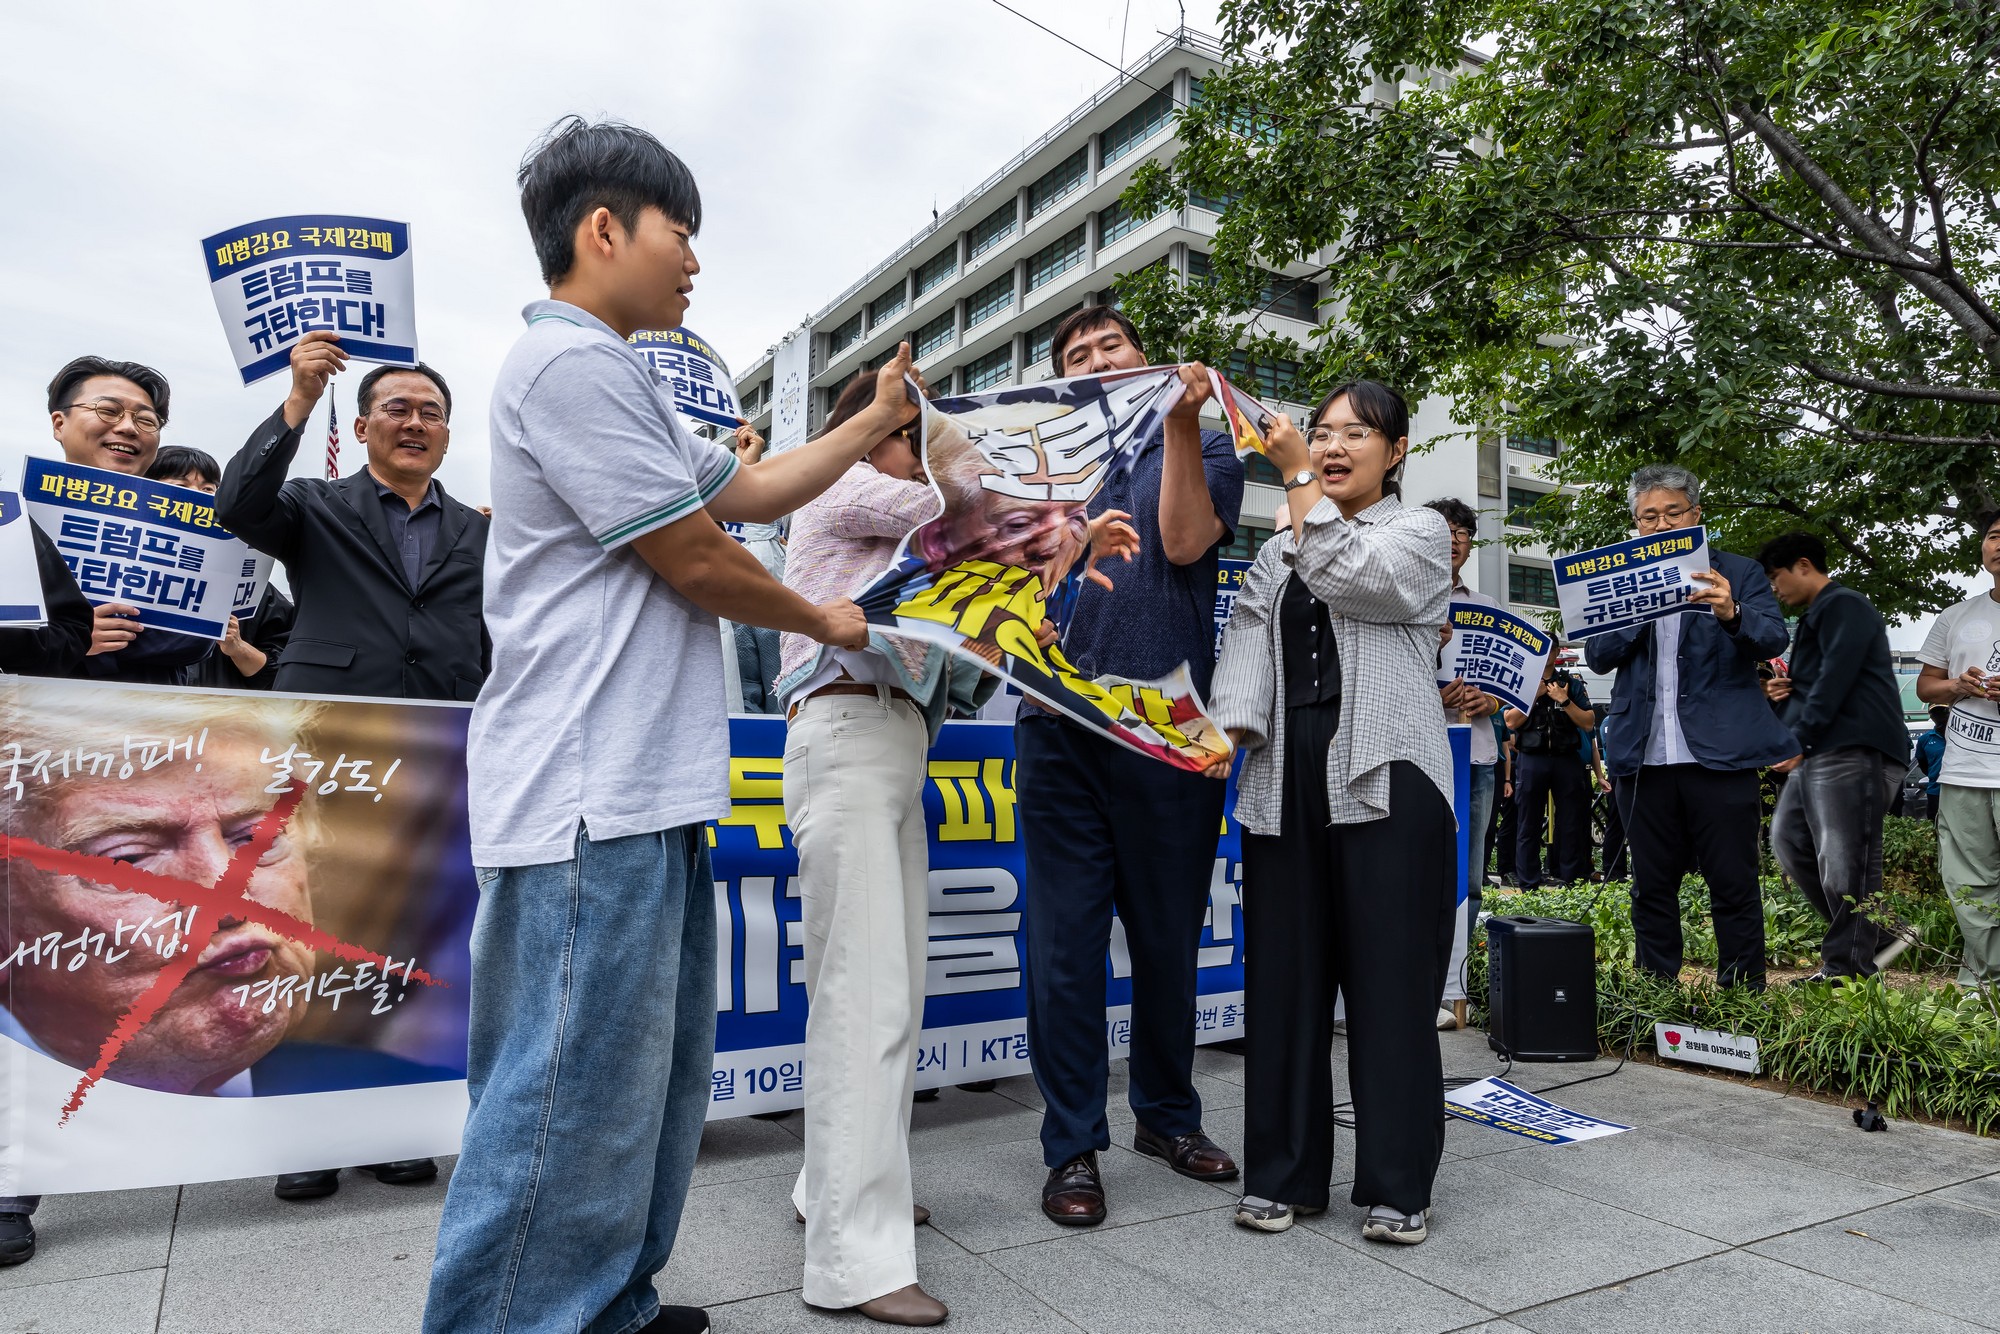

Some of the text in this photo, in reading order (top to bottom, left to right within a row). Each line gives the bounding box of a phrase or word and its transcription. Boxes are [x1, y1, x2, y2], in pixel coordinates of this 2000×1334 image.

[215, 226, 393, 266] 파병강요 국제깡패
[241, 261, 373, 312] 트럼프를
[244, 297, 385, 355] 규탄한다!
[661, 375, 735, 415] 한다!
[39, 474, 139, 511] 파병강요
[147, 494, 232, 534] 국제깡
[57, 513, 206, 573] 트럼프를
[1565, 536, 1693, 577] 파병강요 국제깡패
[1587, 565, 1682, 603] 트럼프를
[1583, 584, 1692, 626] 규탄한다!
[1454, 610, 1543, 654] 파병강요 국제깡패
[1460, 633, 1525, 671] 트럼프를
[1453, 657, 1525, 695] 규탄한다!
[1950, 714, 1994, 742] ALL STAR
[0, 726, 209, 801] 국제깡패!
[259, 742, 402, 803] 날강도!
[232, 955, 416, 1016] 경제수탈!
[1684, 1040, 1752, 1060] 정원을 아껴주세요
[744, 1060, 803, 1095] 10일
